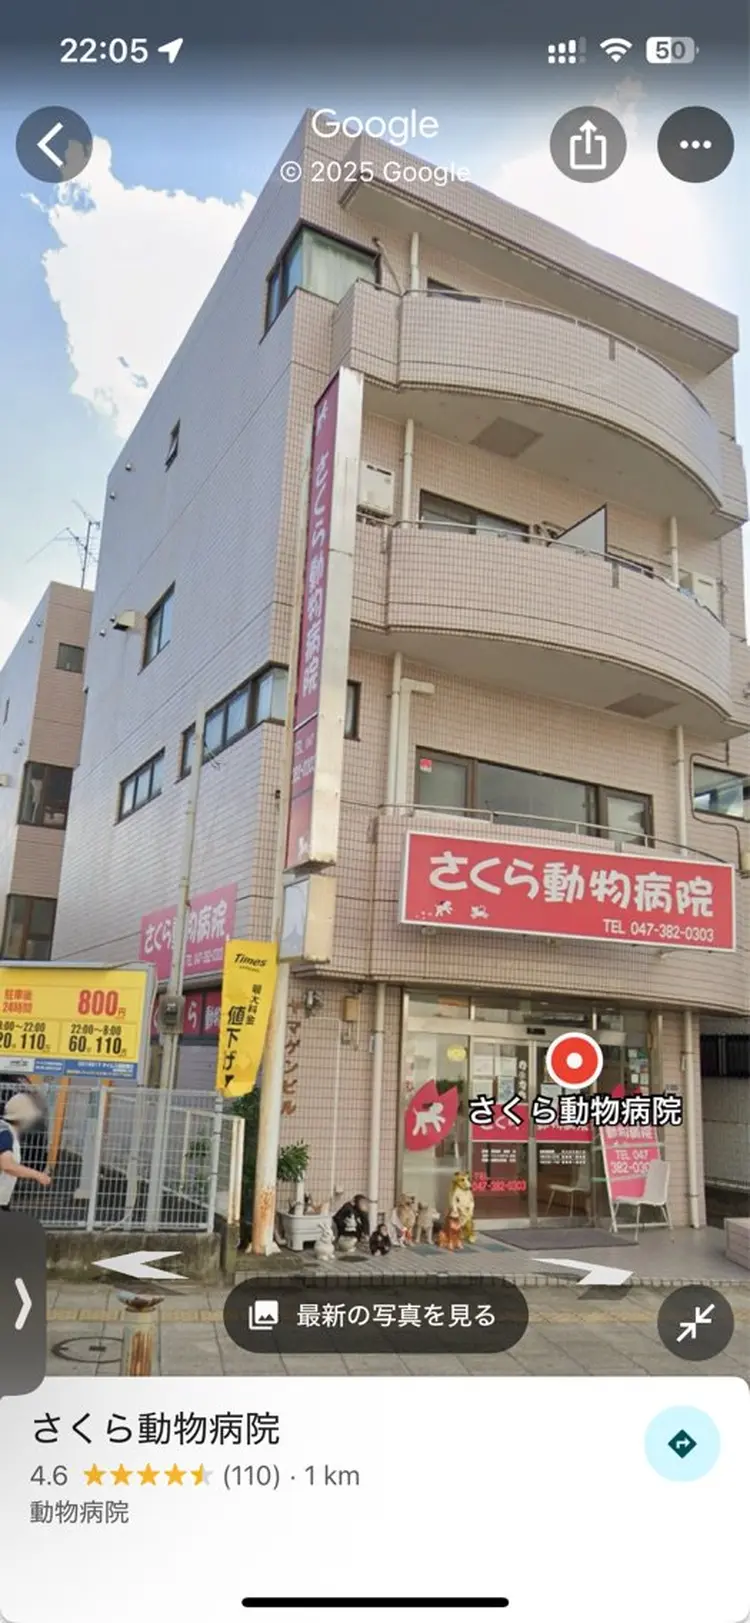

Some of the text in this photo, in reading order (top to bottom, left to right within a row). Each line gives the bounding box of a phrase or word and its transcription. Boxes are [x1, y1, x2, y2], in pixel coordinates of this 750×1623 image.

[428, 851, 715, 918] さくら動物病院
[144, 898, 228, 955] さくら物病院
[603, 918, 715, 942] TEL 047-382-0303
[233, 953, 267, 967] Times
[223, 1005, 247, 1071] 値下げ
